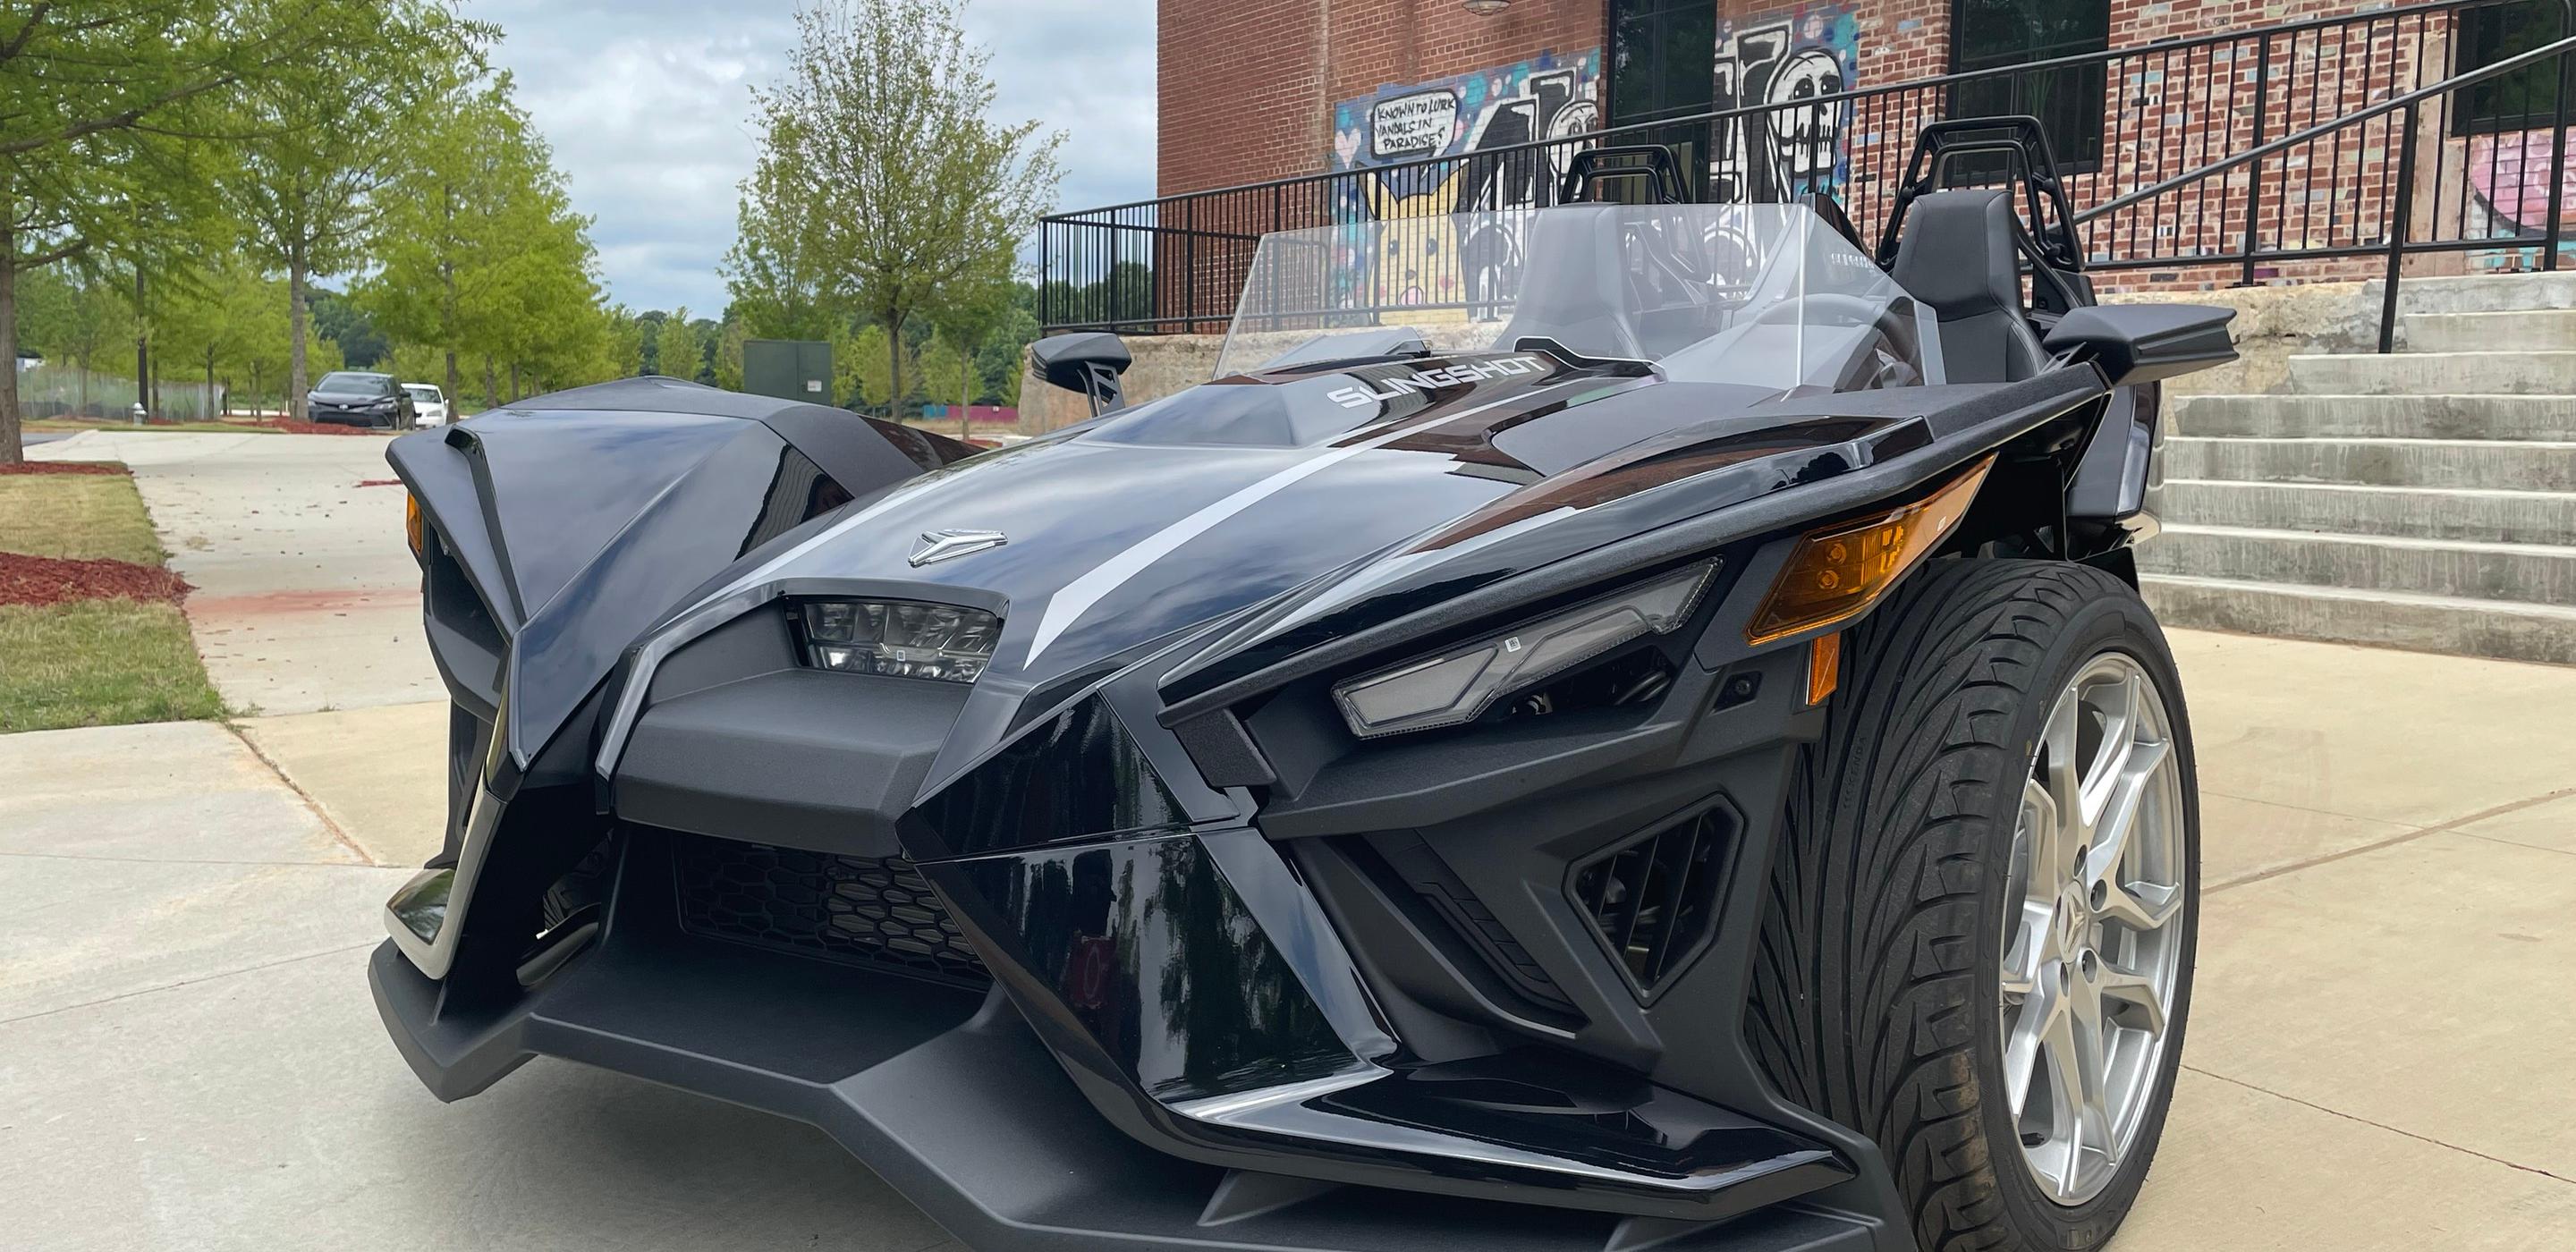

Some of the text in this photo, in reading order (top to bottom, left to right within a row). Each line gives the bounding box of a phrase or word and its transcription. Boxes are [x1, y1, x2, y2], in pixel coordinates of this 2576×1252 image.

[1377, 98, 1455, 122] KNOWN TO LURK
[1375, 117, 1433, 139] VANDALS IN
[1326, 356, 1546, 409] SLINGSHOT
